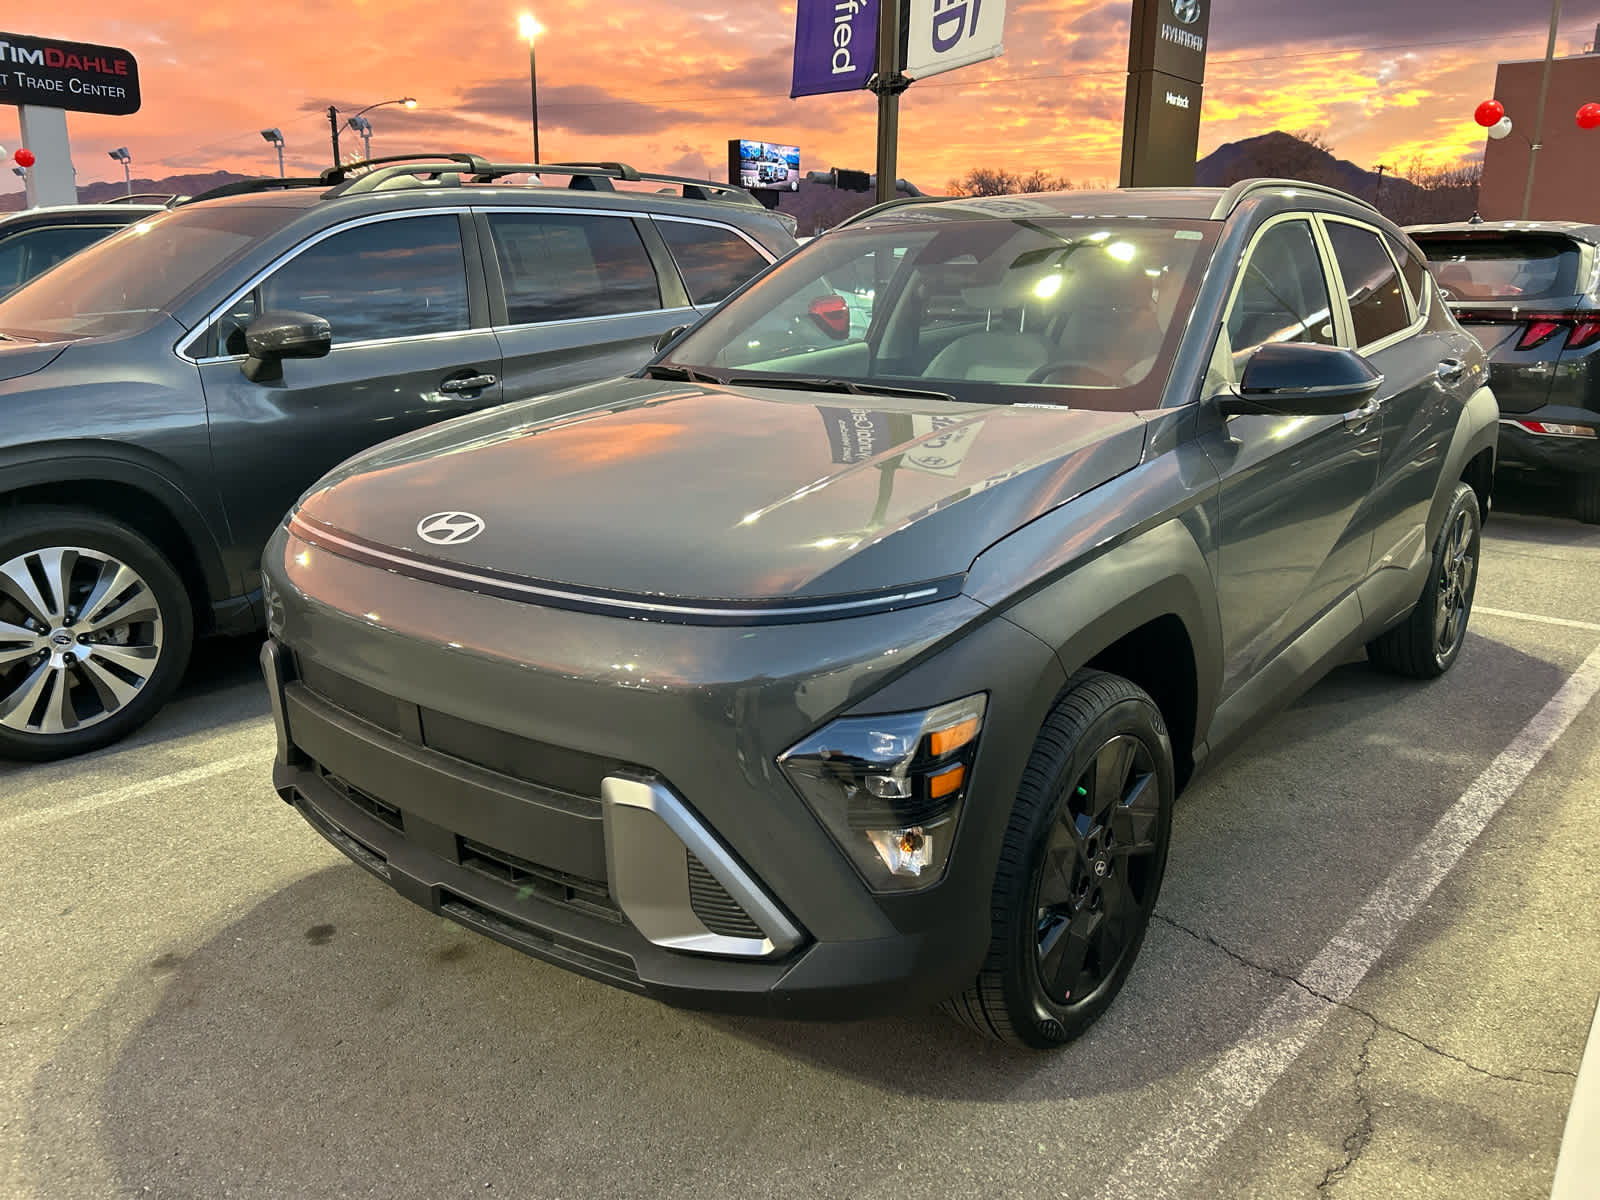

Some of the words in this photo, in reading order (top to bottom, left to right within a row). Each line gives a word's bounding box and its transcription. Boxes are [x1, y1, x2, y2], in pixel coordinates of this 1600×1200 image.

[1162, 24, 1203, 52] HYUNDAI
[13, 71, 65, 92] TRADE
[69, 78, 126, 98] CENTER
